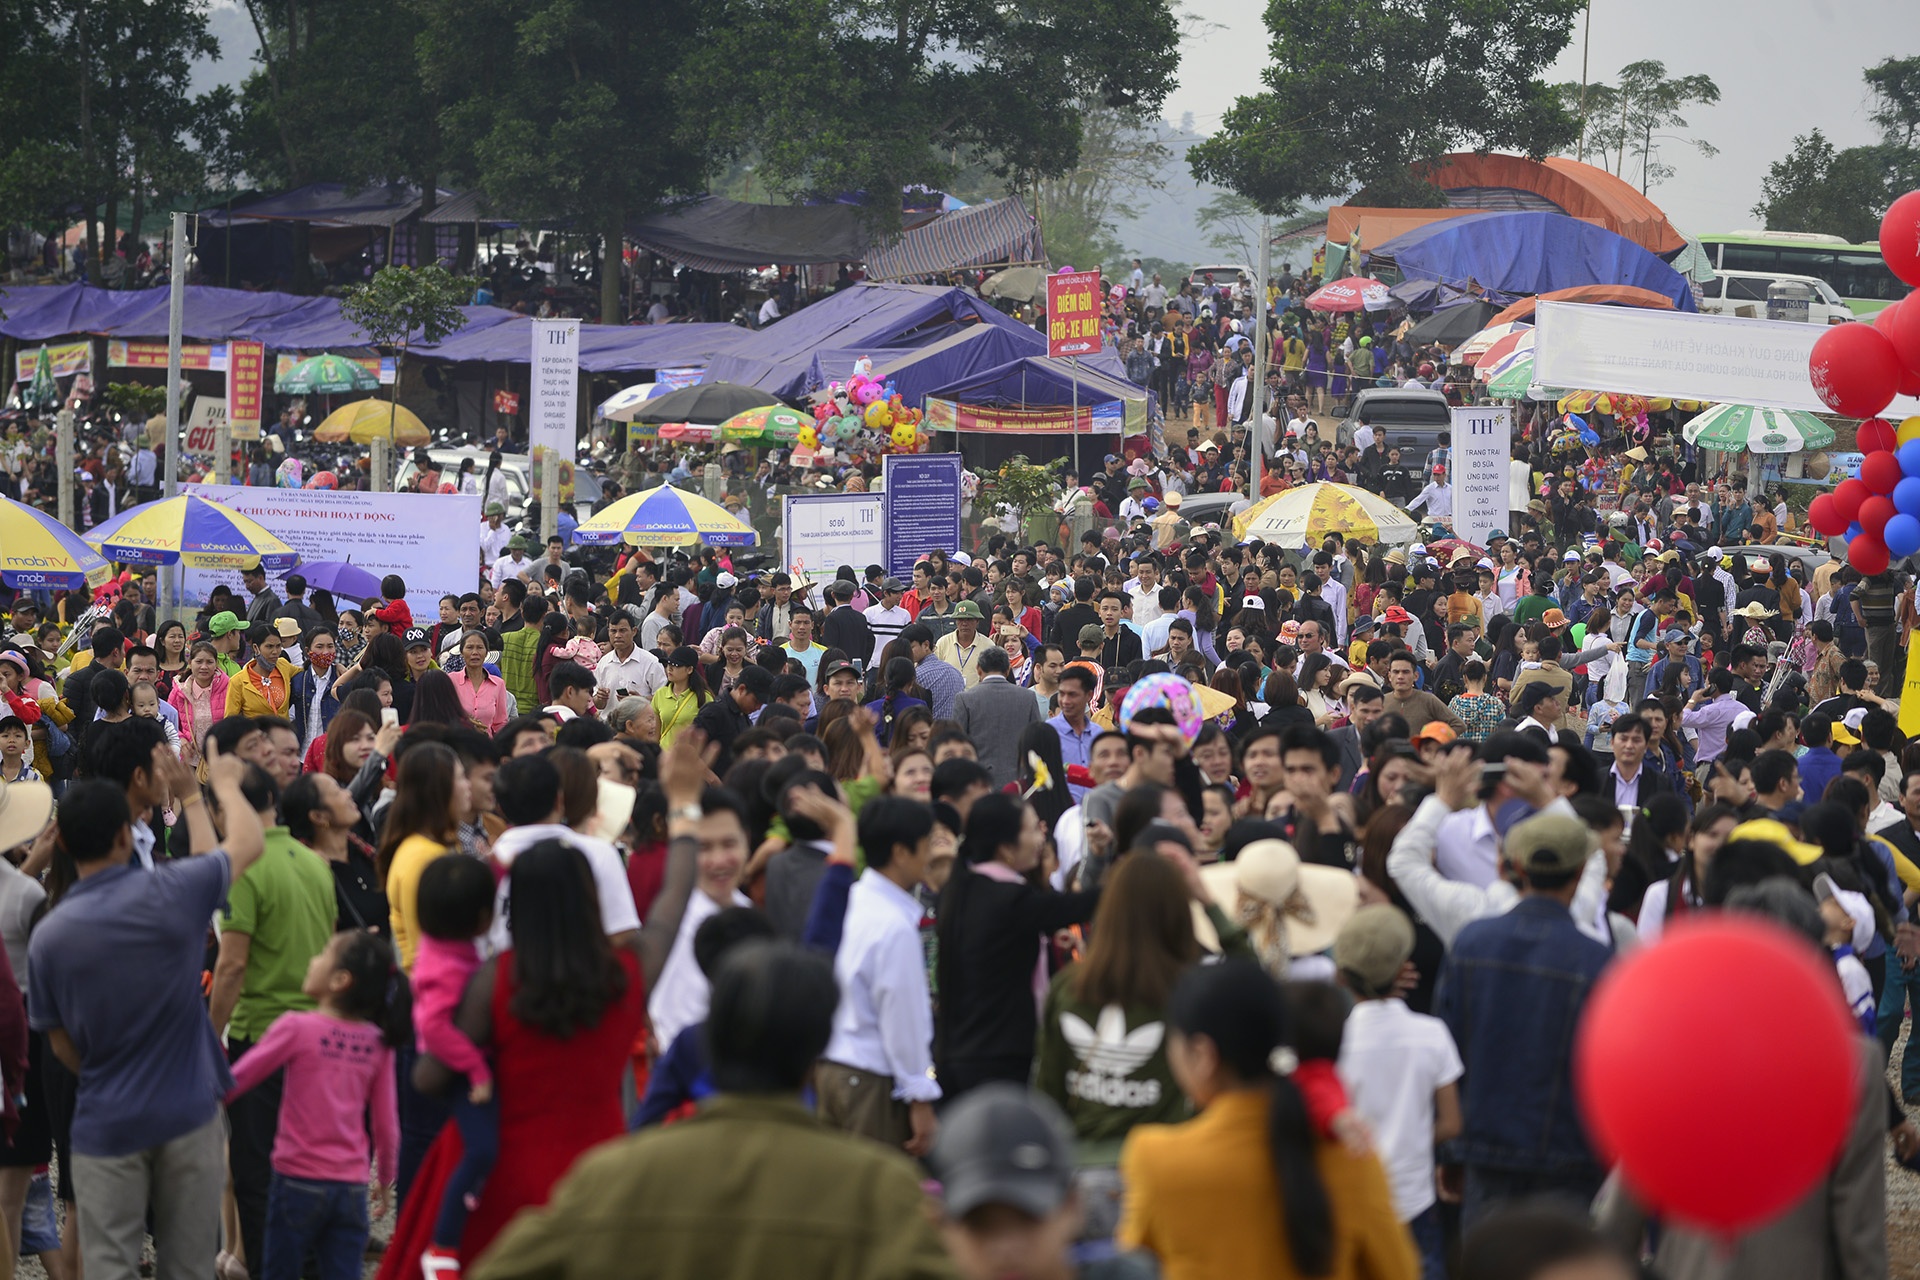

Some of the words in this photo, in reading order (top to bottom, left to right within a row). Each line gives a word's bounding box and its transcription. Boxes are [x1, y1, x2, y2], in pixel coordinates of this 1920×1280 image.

[1057, 286, 1077, 314] ĐIỂM
[1079, 284, 1092, 312] GỬI
[1051, 317, 1066, 340] ÔTÔ
[1070, 320, 1080, 338] XE
[1082, 314, 1099, 337] MÁY
[547, 330, 566, 344] TH
[1066, 409, 1087, 417] DƯNG
[976, 419, 996, 429] HUYỆN
[1002, 420, 1022, 429] NGHĨA
[1023, 420, 1036, 429] ĐÀN
[1037, 420, 1052, 429] NĂM
[1468, 418, 1494, 435] TH
[1467, 472, 1480, 480] ỨNG
[1484, 484, 1500, 492] NGHỆ
[244, 506, 291, 517] CHƯƠNG
[294, 508, 327, 518] TRÌNH
[331, 512, 360, 521] HOẠT
[364, 513, 395, 522] ĐỘNG
[860, 509, 874, 522] TH
[1469, 509, 1480, 517] LỚN
[1482, 507, 1497, 516] NHẤT
[837, 517, 845, 527] ĐỒ
[1266, 517, 1291, 530] TH
[1375, 514, 1400, 524] TH
[115, 535, 176, 547] mobiTV
[709, 534, 744, 542] mobifone
[116, 549, 164, 559] mobifone
[194, 554, 244, 564] mobifone
[7, 556, 68, 567] mobiTV
[17, 573, 68, 583] mobifone
[1065, 1069, 1162, 1108] adidas
